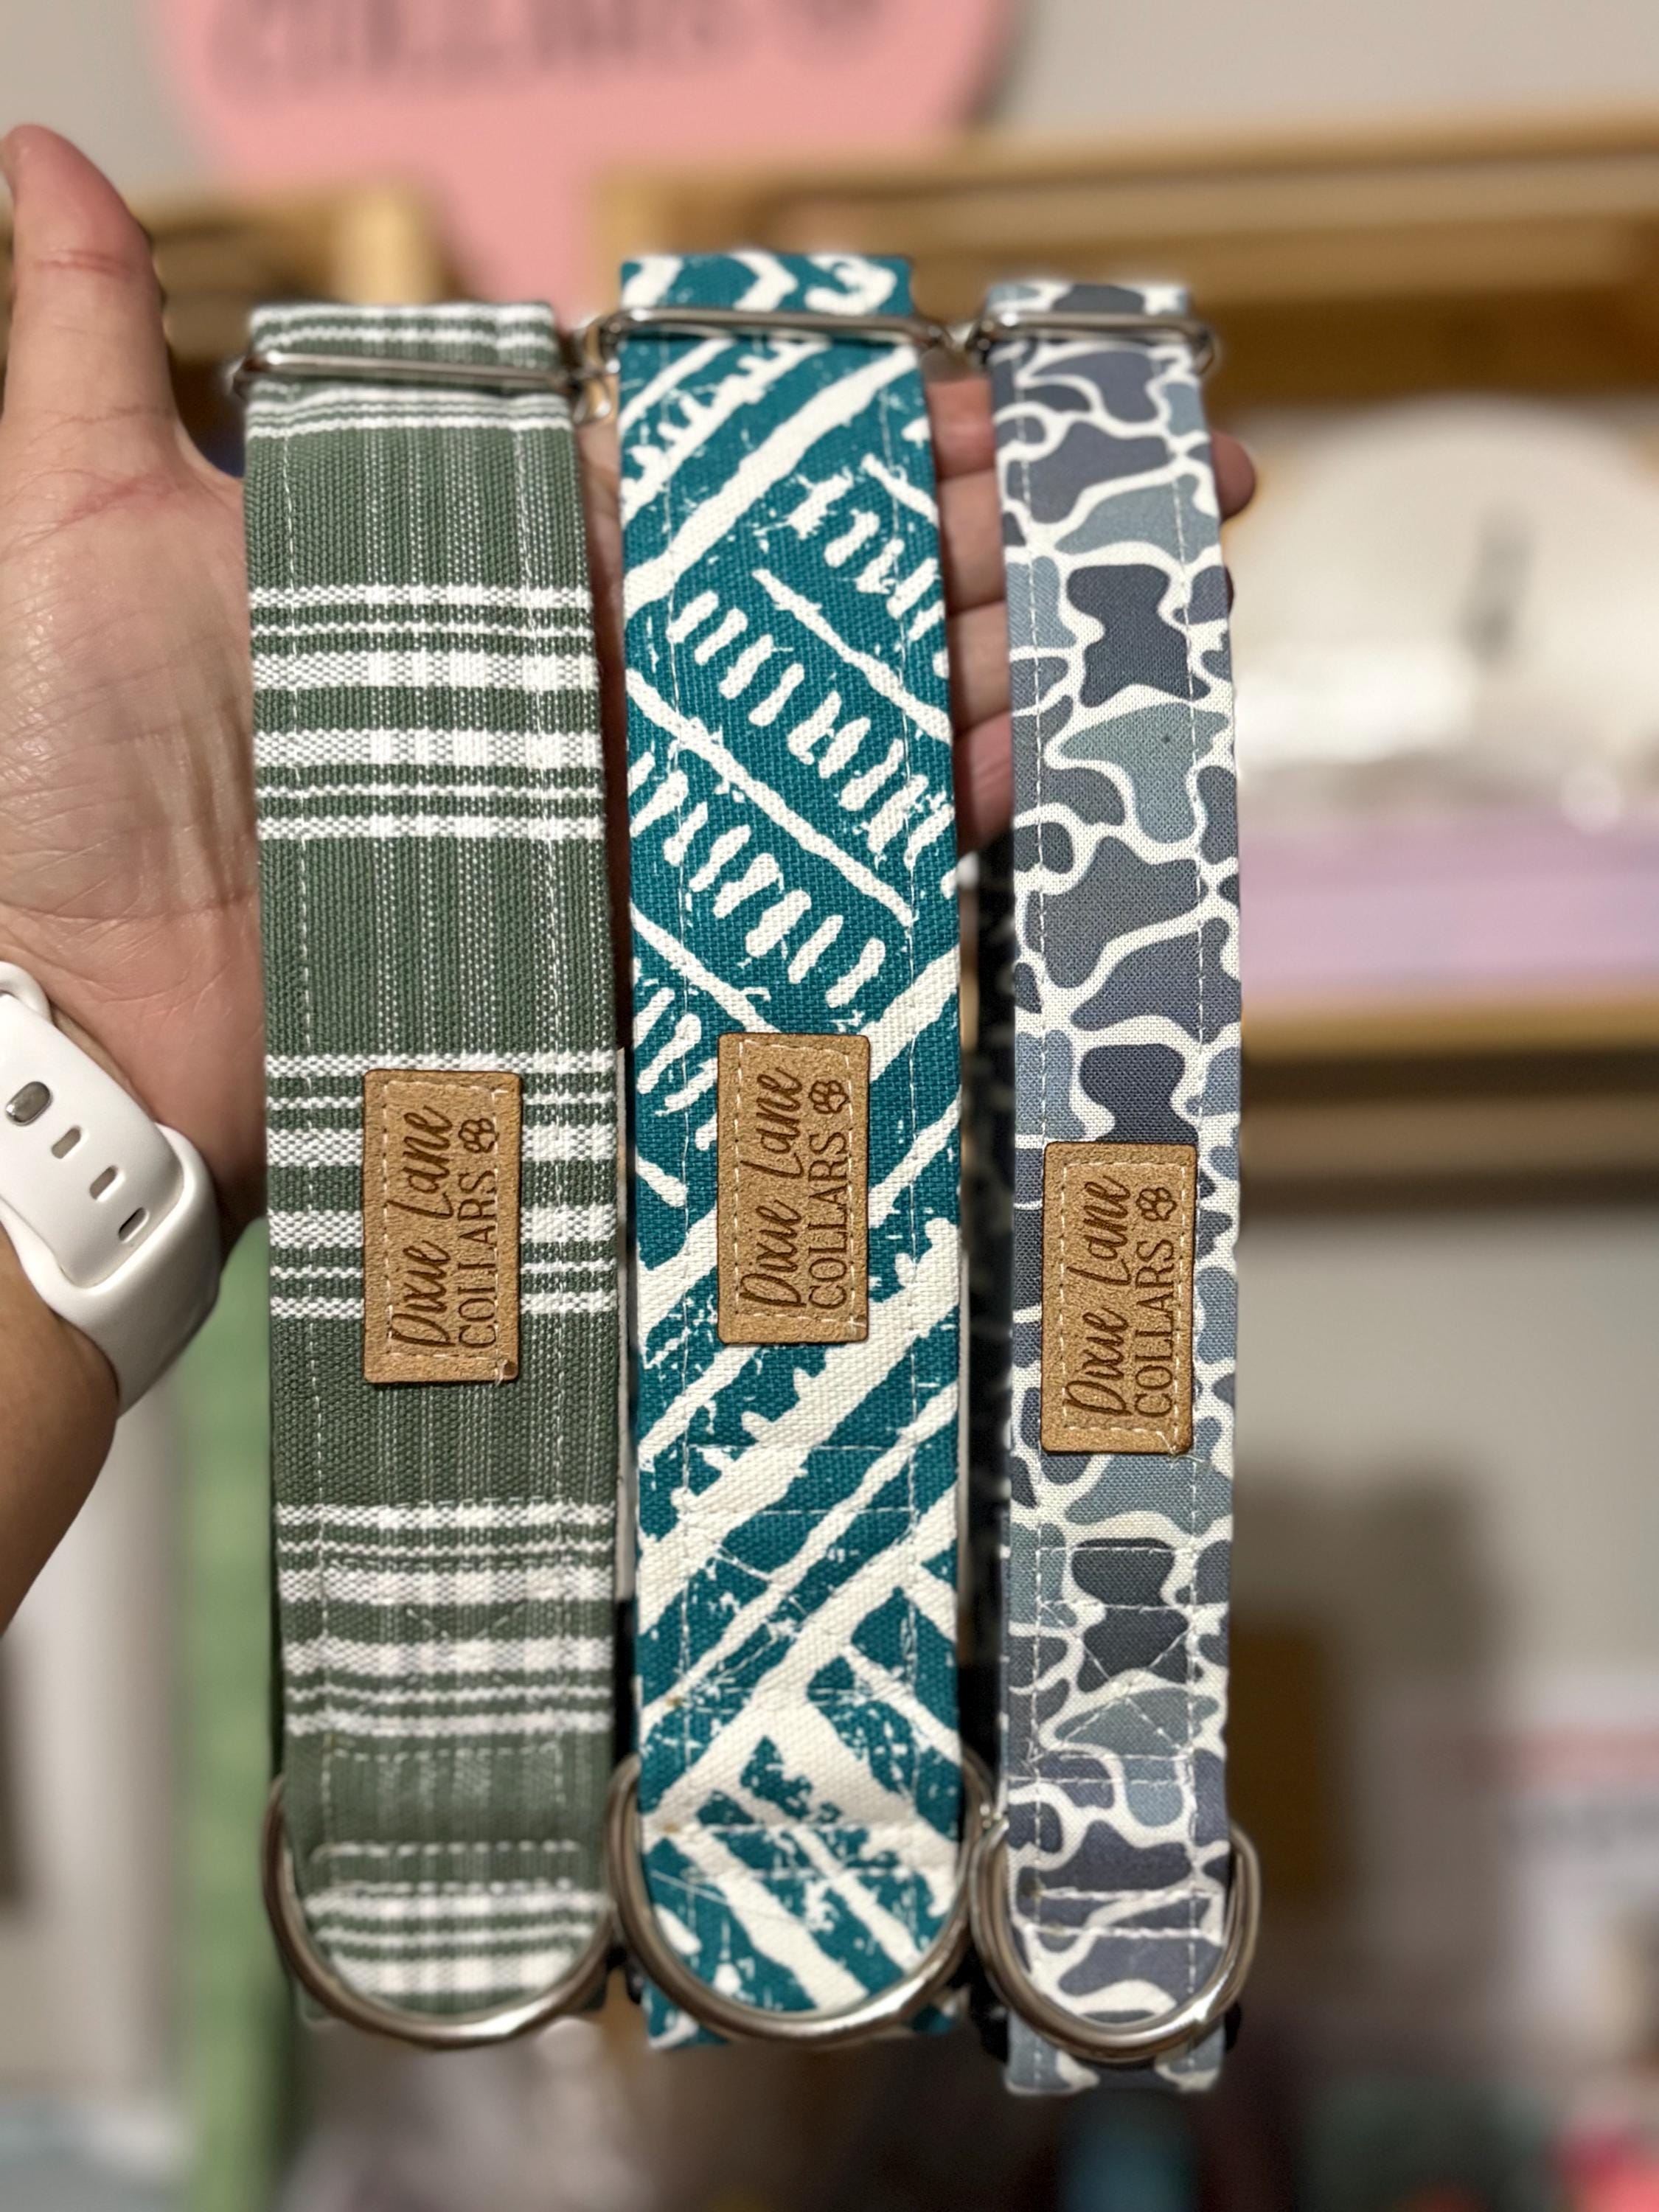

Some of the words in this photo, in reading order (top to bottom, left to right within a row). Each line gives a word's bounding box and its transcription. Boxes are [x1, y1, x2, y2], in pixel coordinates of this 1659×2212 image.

[387, 1105, 453, 1220] Lane
[740, 1067, 803, 1179] Lane
[458, 1171, 496, 1349] COLLARS
[739, 1200, 807, 1309] Dixie
[809, 1132, 847, 1310] COLLARS
[1067, 1175, 1132, 1287] Lane
[390, 1240, 456, 1348] Dixie
[1135, 1239, 1174, 1417] COLLARS
[1064, 1308, 1133, 1416] Dixie
